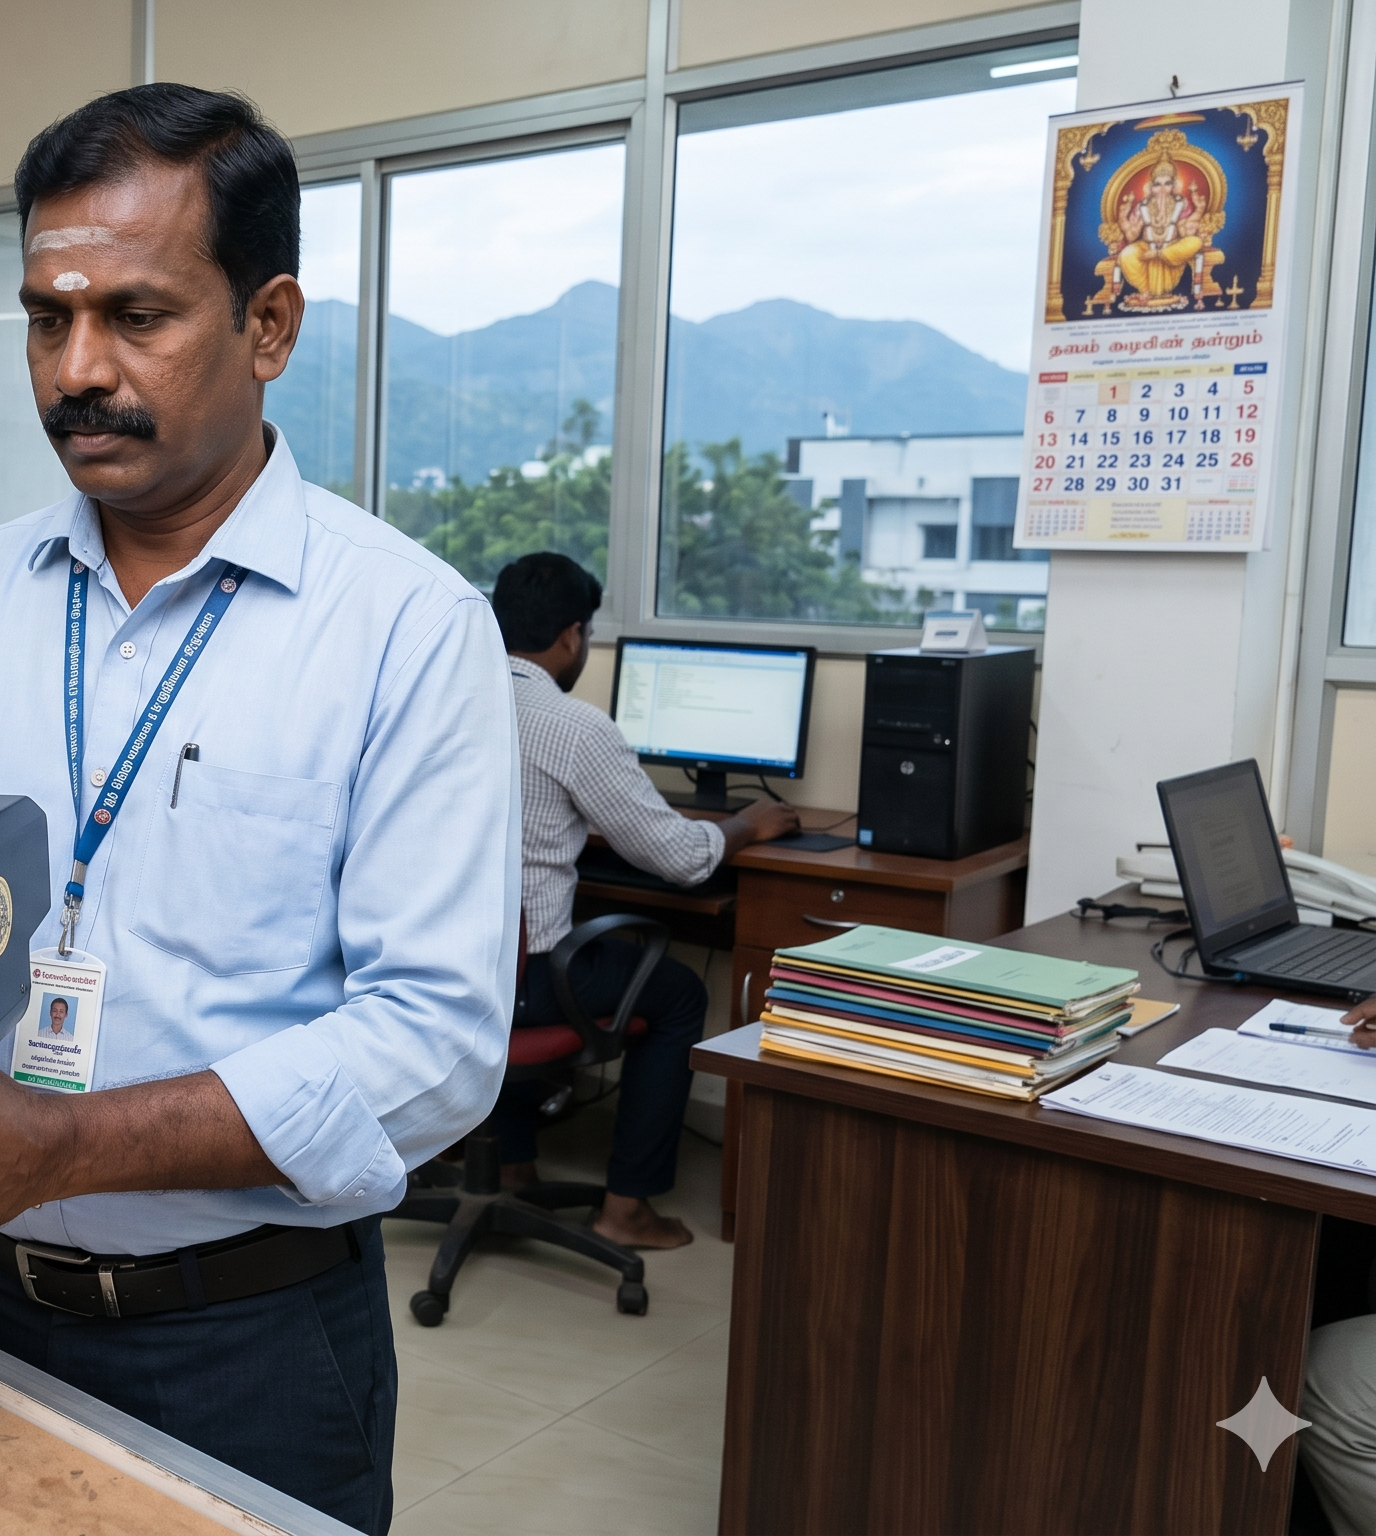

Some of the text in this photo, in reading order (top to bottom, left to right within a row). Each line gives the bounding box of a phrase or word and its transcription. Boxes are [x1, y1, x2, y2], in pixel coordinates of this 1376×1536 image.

[1111, 380, 1254, 398] 1 2 3 4 5
[1044, 404, 1258, 424] 6 7 8 9 10 11 12
[1039, 428, 1256, 447] 13 14 15 16 17 18 19
[1035, 453, 1253, 469] 20 21 22 23 24 25 26
[1033, 477, 1180, 492] 27 28 29 30 31
